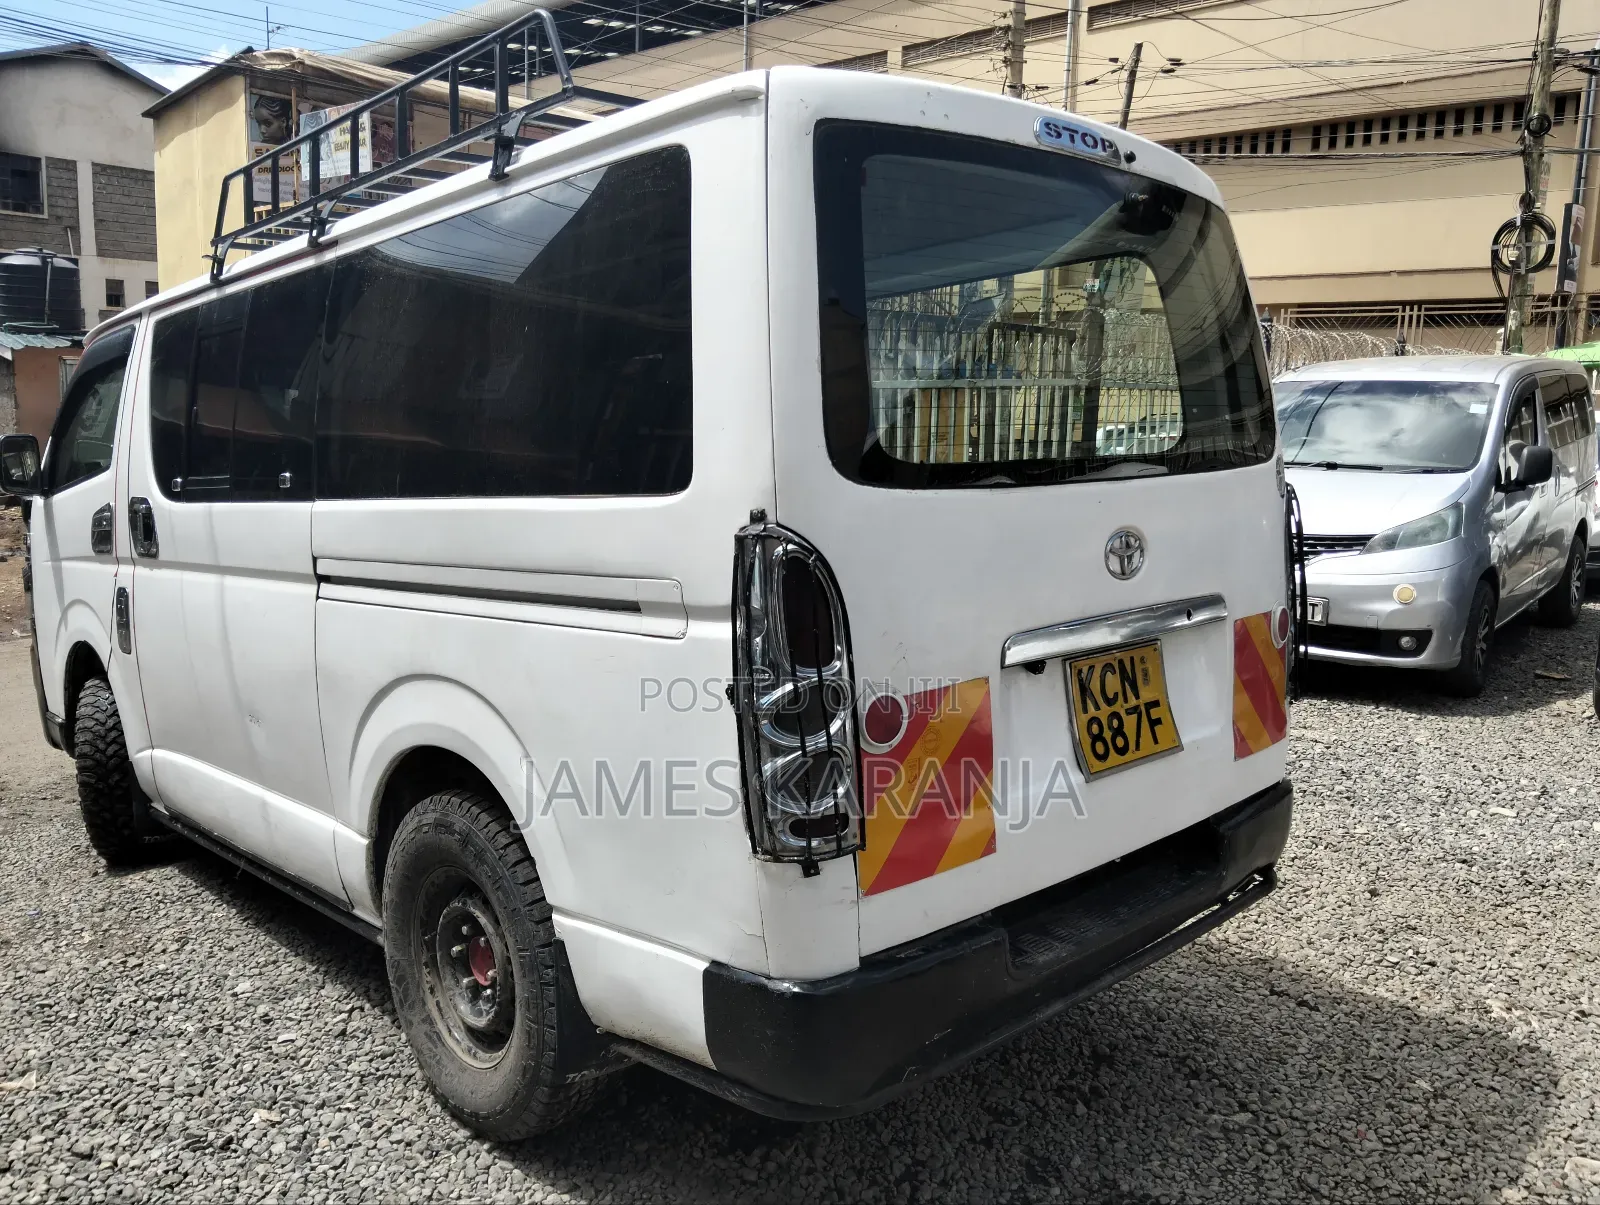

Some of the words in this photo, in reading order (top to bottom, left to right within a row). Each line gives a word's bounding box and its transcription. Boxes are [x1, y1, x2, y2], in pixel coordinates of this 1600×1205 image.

[1044, 121, 1114, 153] STOP
[1077, 655, 1141, 714] KCN
[1086, 699, 1163, 763] 887F
